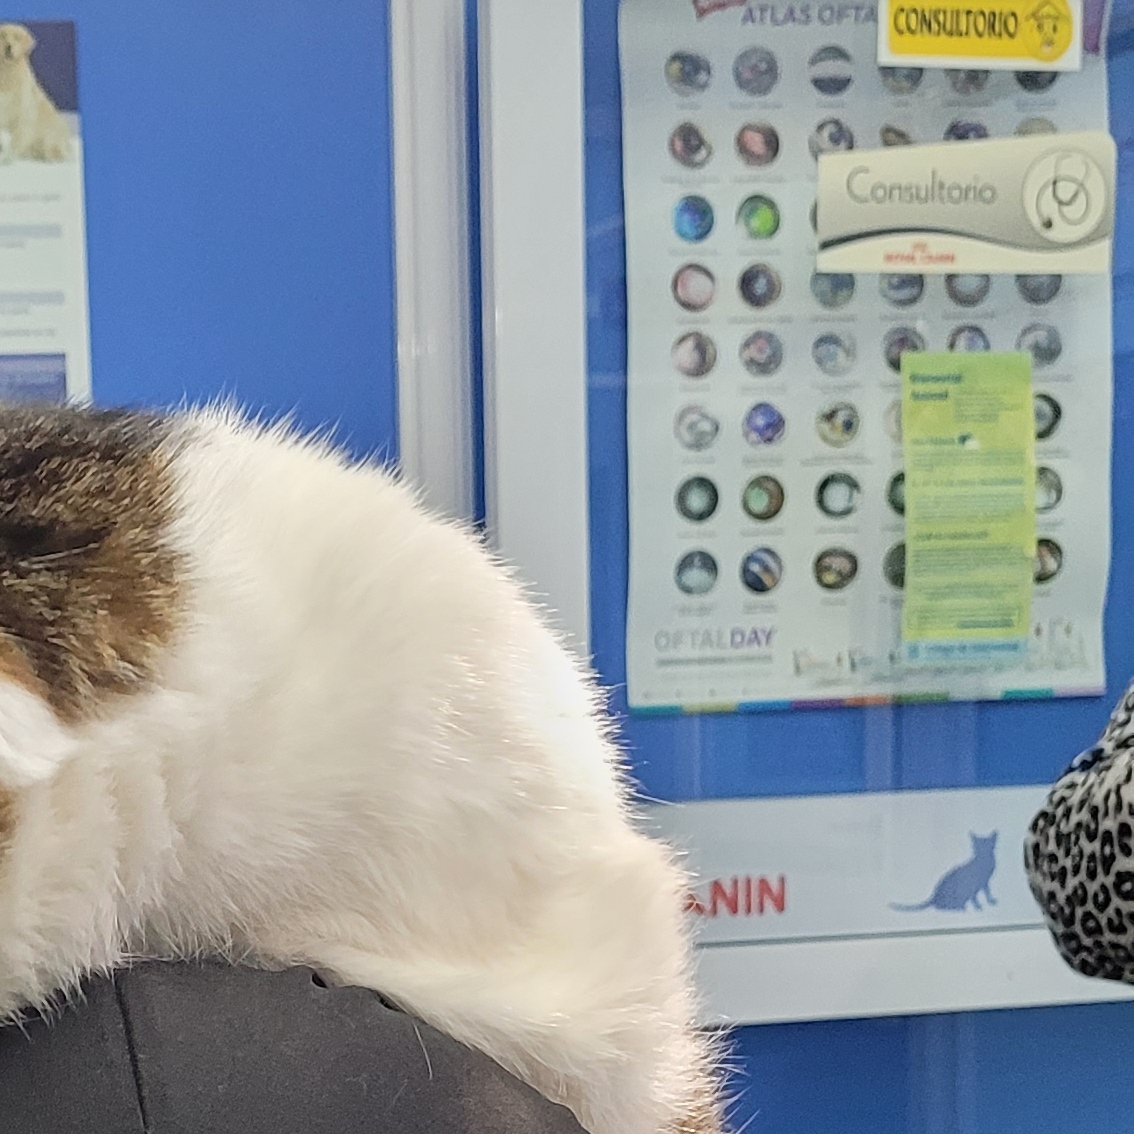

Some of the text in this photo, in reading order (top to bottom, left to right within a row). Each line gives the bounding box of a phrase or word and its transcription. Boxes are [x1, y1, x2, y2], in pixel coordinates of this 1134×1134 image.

[741, 3, 812, 26] ATLAS
[893, 7, 1018, 39] CONSULTORIO
[846, 165, 998, 204] Consultorio
